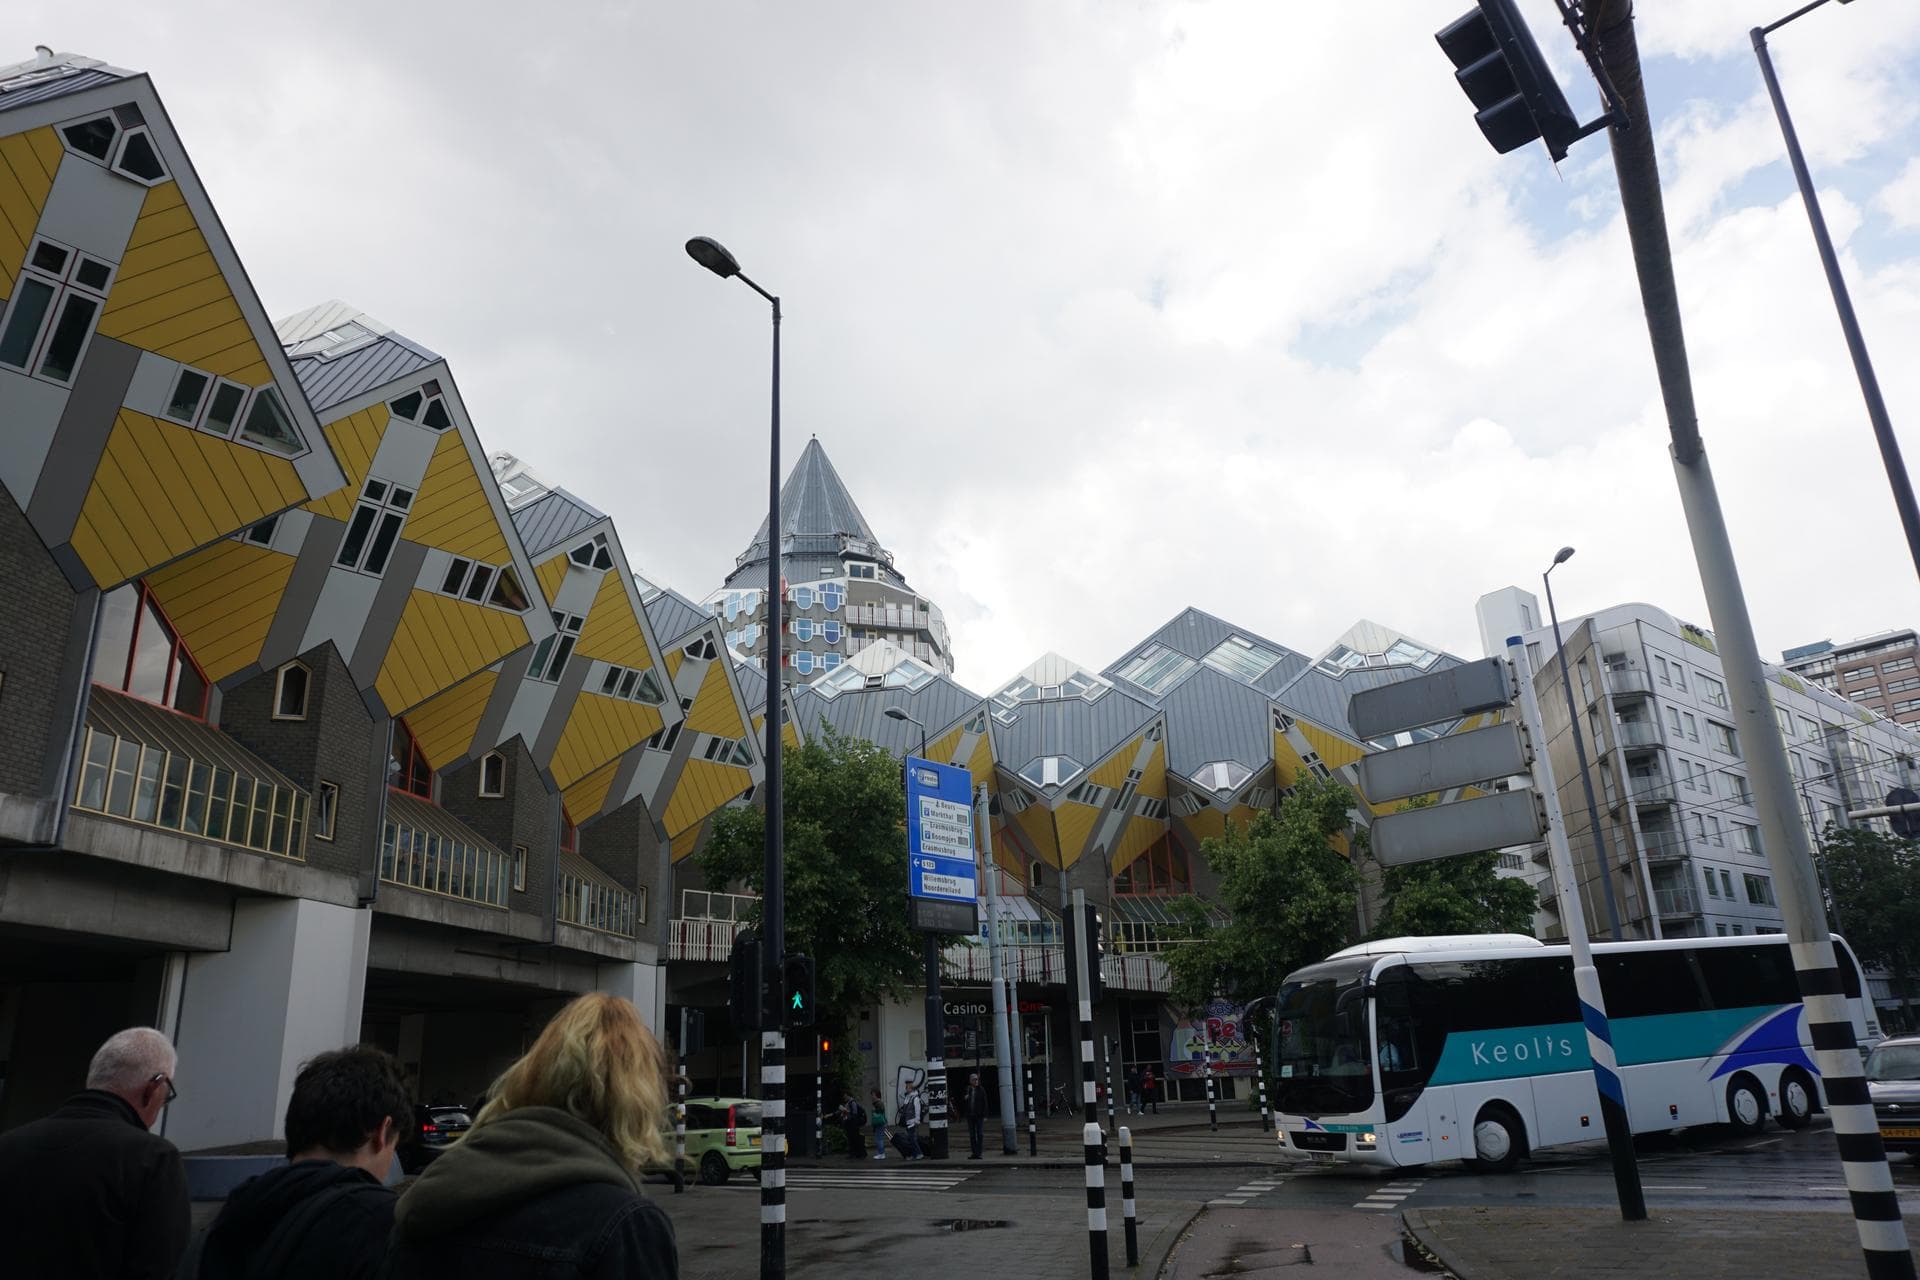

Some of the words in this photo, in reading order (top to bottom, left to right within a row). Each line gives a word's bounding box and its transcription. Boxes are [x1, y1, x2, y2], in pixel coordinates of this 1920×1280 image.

[931, 810, 953, 820] Markthal
[930, 821, 962, 835] Erasmusbrug
[932, 833, 956, 843] Boompjes
[922, 843, 956, 856] Erasmusbrug
[923, 874, 956, 886] Willemsbrug
[943, 1002, 987, 1015] Casino
[1471, 1035, 1572, 1065] Keolis
